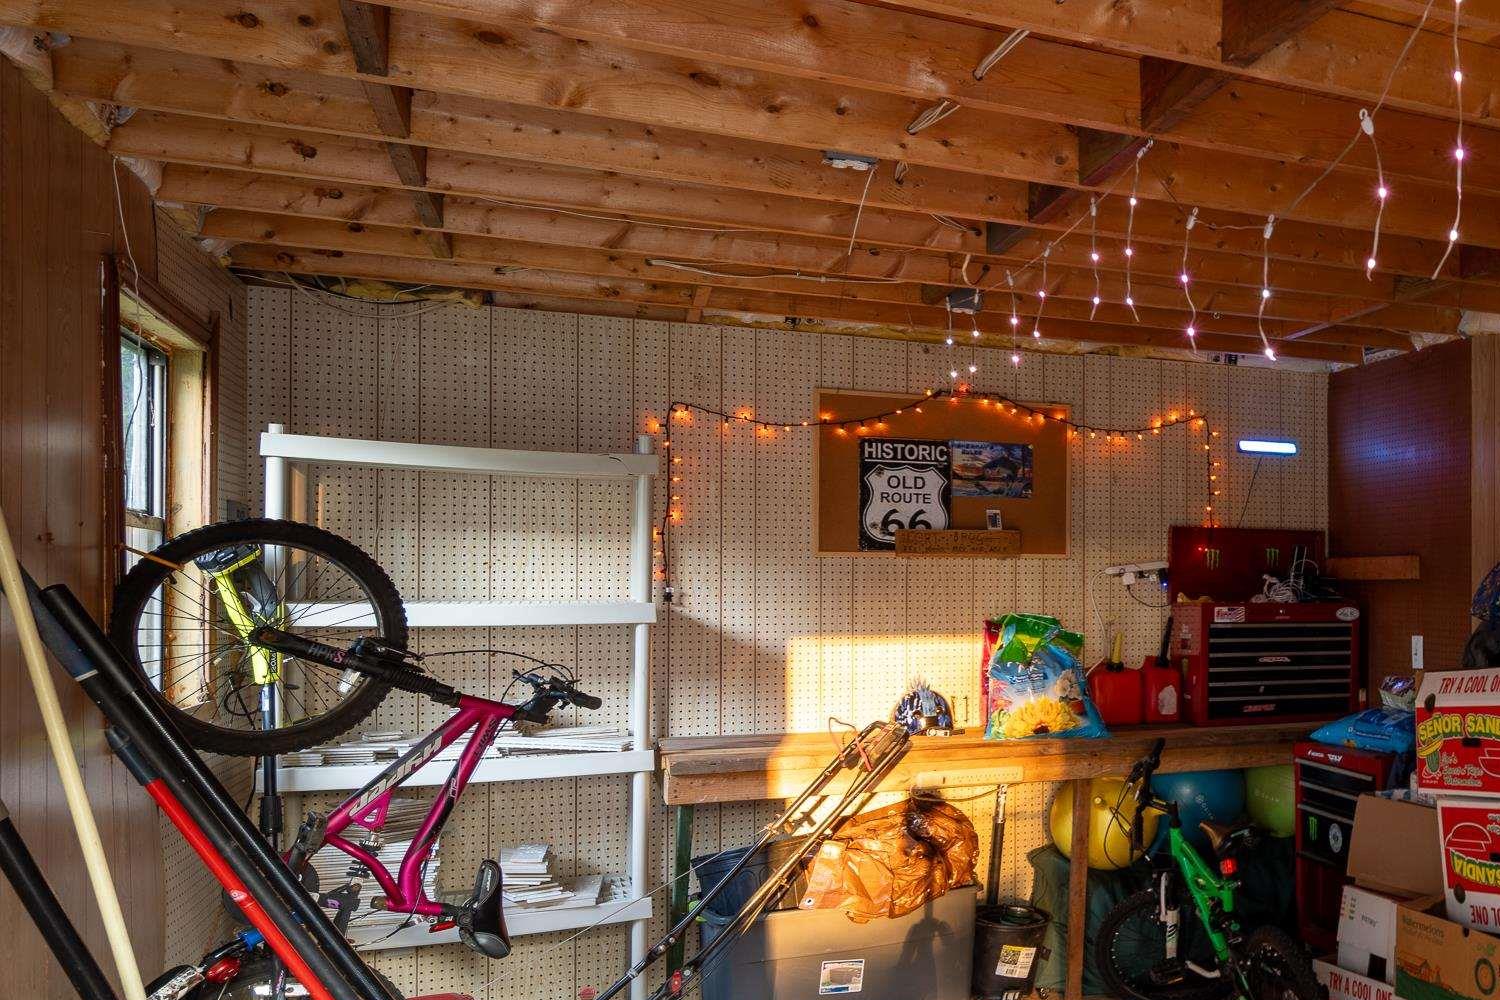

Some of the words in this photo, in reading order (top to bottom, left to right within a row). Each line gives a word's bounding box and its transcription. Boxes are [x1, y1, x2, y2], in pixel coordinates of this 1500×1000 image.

[864, 442, 948, 462] HISTORIC
[886, 475, 926, 490] OLD
[880, 491, 931, 504] ROUTE
[880, 508, 932, 536] 66
[1438, 677, 1457, 694] TRY
[1455, 677, 1464, 693] A
[1464, 675, 1488, 693] COOL
[1419, 713, 1464, 747] SEÑOR
[349, 735, 443, 817] HYPER
[1470, 904, 1488, 924] ONE
[1329, 972, 1343, 993] TRY
[1344, 975, 1350, 995] A
